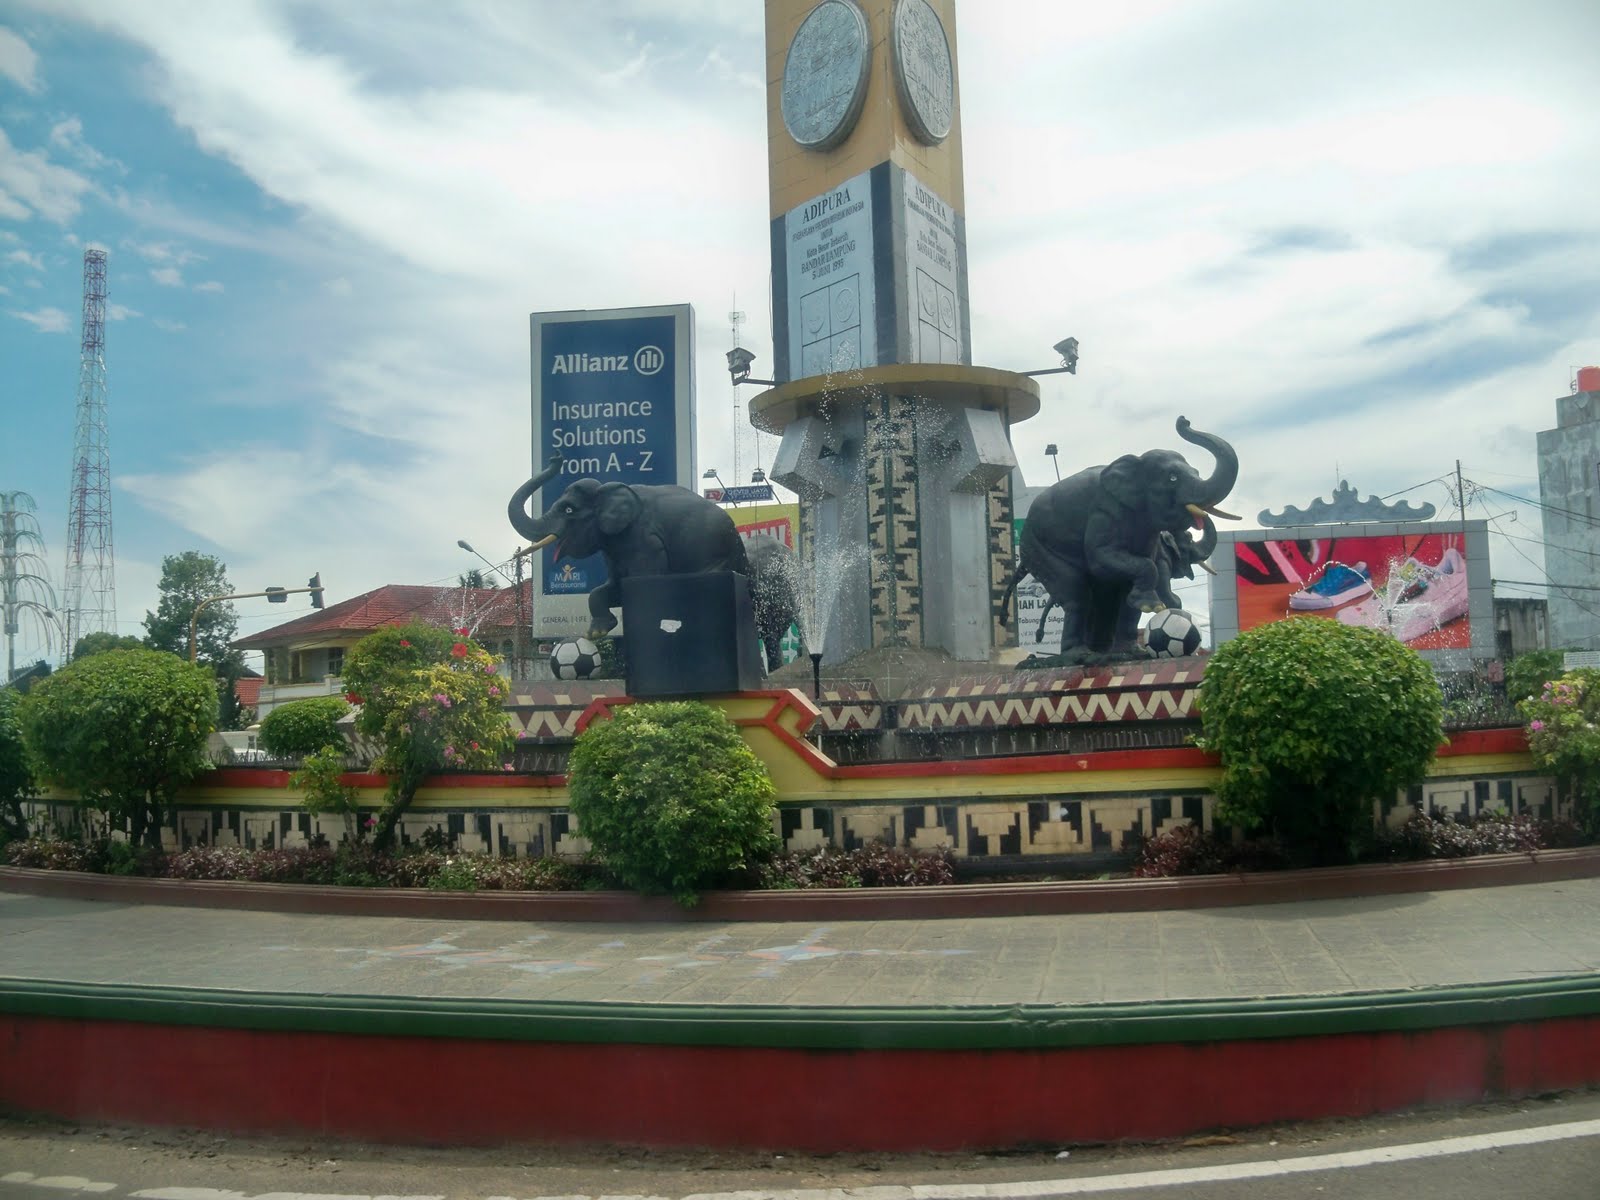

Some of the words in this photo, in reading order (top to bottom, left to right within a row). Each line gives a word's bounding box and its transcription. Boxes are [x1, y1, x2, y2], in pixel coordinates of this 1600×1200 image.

[803, 187, 851, 224] ADIPURA
[552, 353, 628, 374] Allianz
[553, 400, 652, 420] Insurance
[552, 424, 646, 448] Solutions
[559, 456, 600, 475] rom
[605, 452, 621, 472] A
[639, 451, 653, 471] Z
[550, 581, 586, 589] Berasuransi
[1018, 600, 1034, 610] IAH
[542, 616, 568, 624] GENERAL
